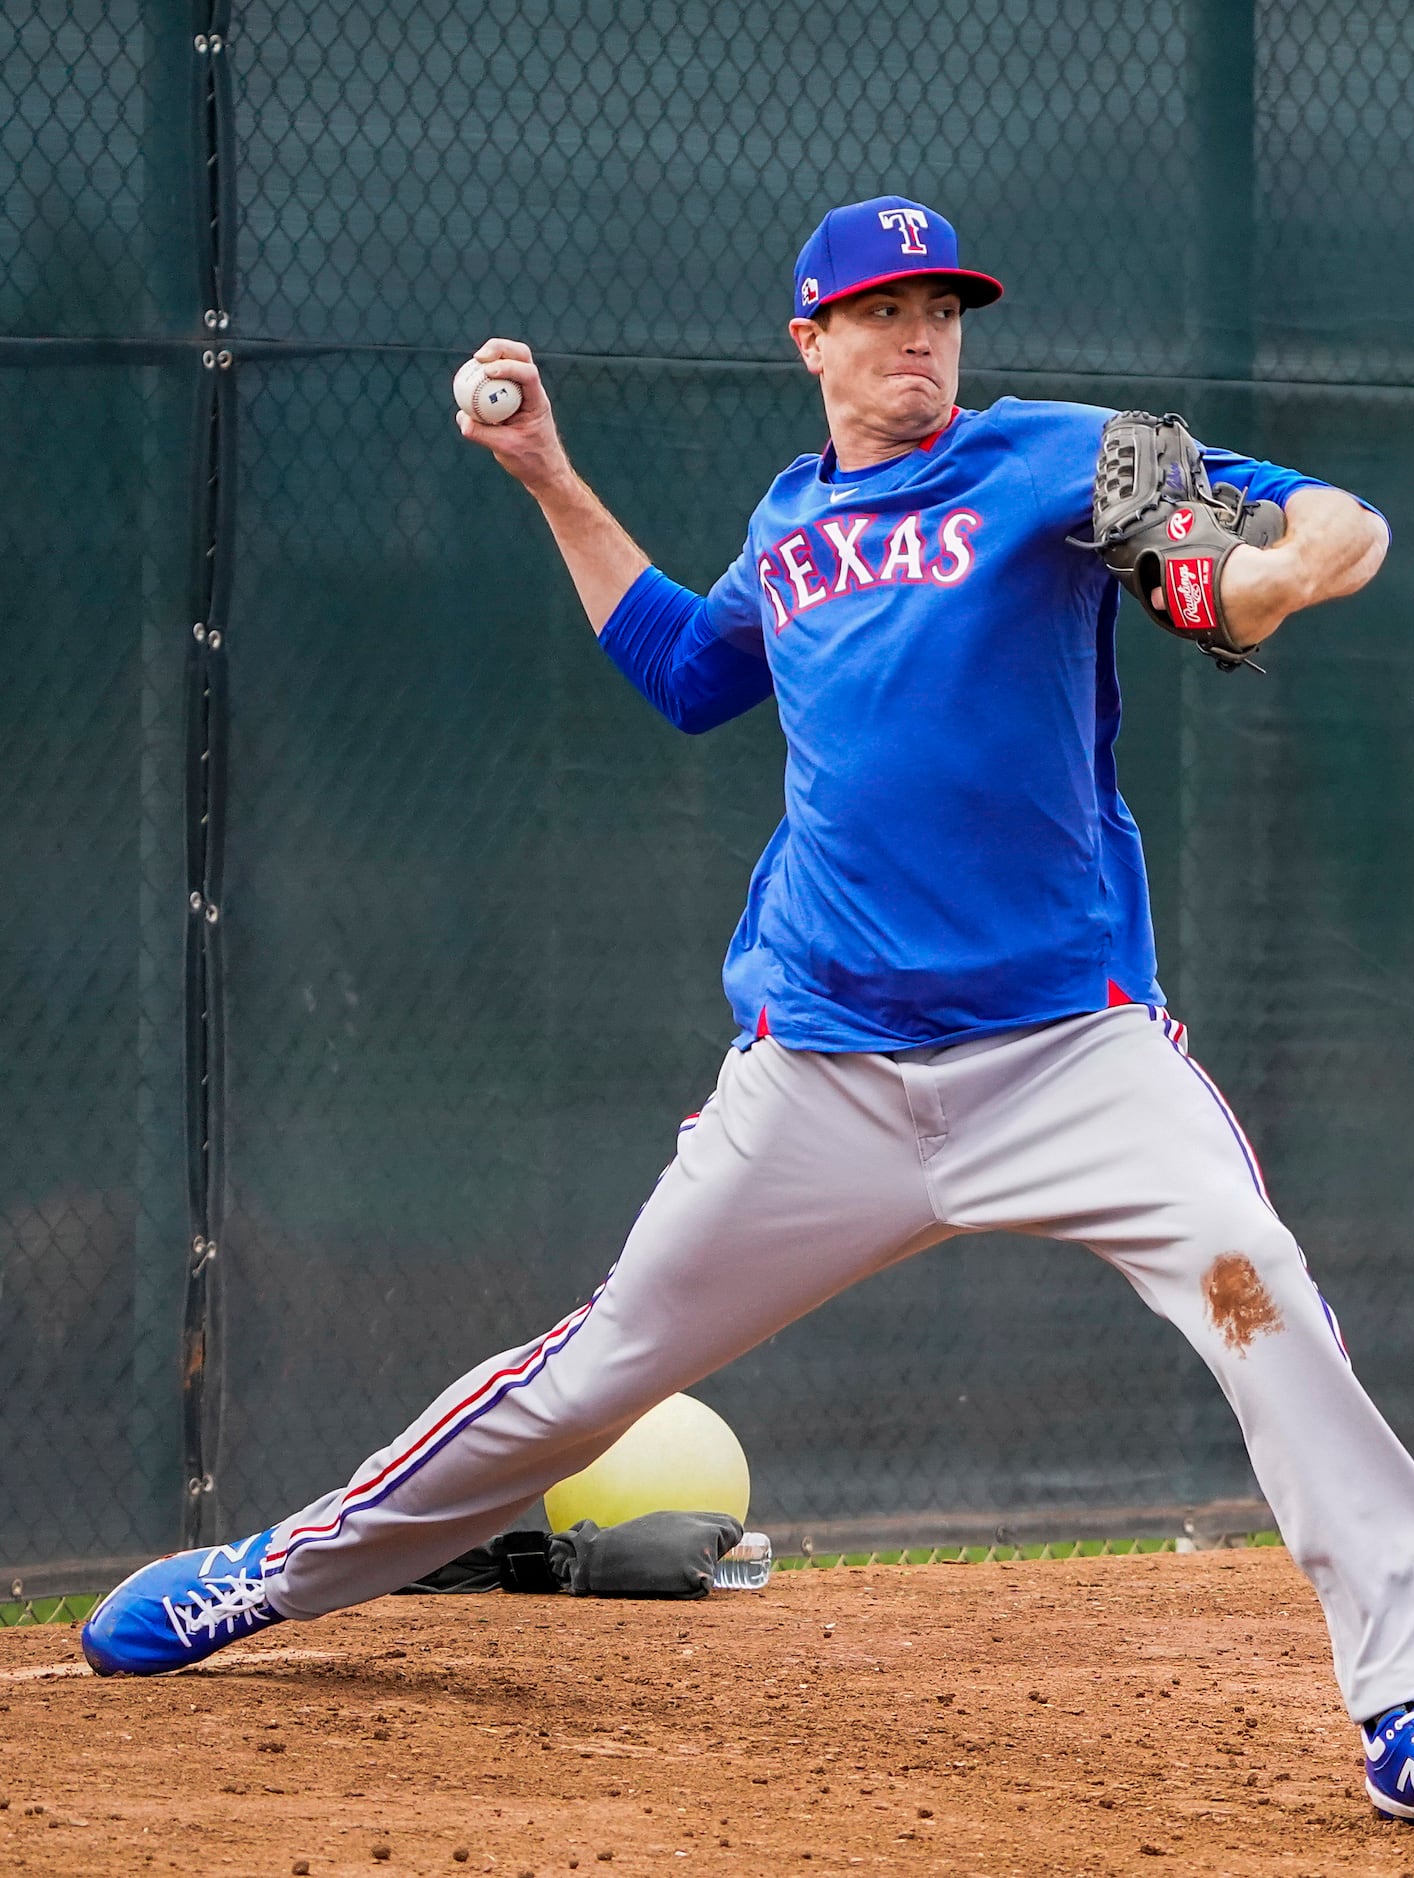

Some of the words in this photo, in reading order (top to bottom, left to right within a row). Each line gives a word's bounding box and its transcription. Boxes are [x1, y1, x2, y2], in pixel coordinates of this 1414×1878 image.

[877, 207, 930, 256] T
[757, 507, 983, 636] TEXAS
[1177, 564, 1202, 623] Rawlings
